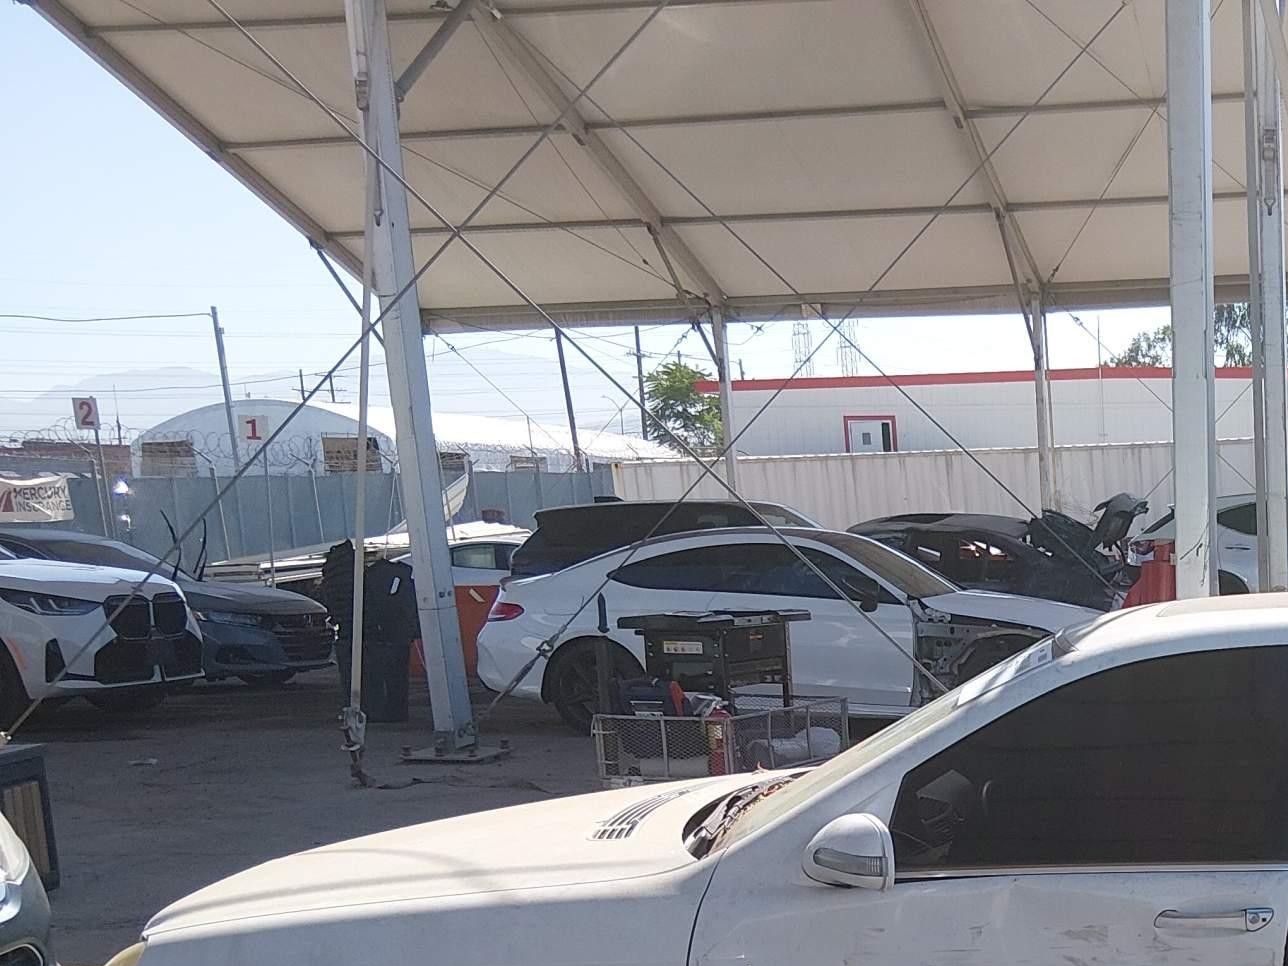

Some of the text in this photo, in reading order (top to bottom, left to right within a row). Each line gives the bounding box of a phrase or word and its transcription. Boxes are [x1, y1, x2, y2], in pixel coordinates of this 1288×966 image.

[79, 401, 95, 426] 2
[245, 418, 262, 441] 1
[13, 486, 67, 500] MERCURY
